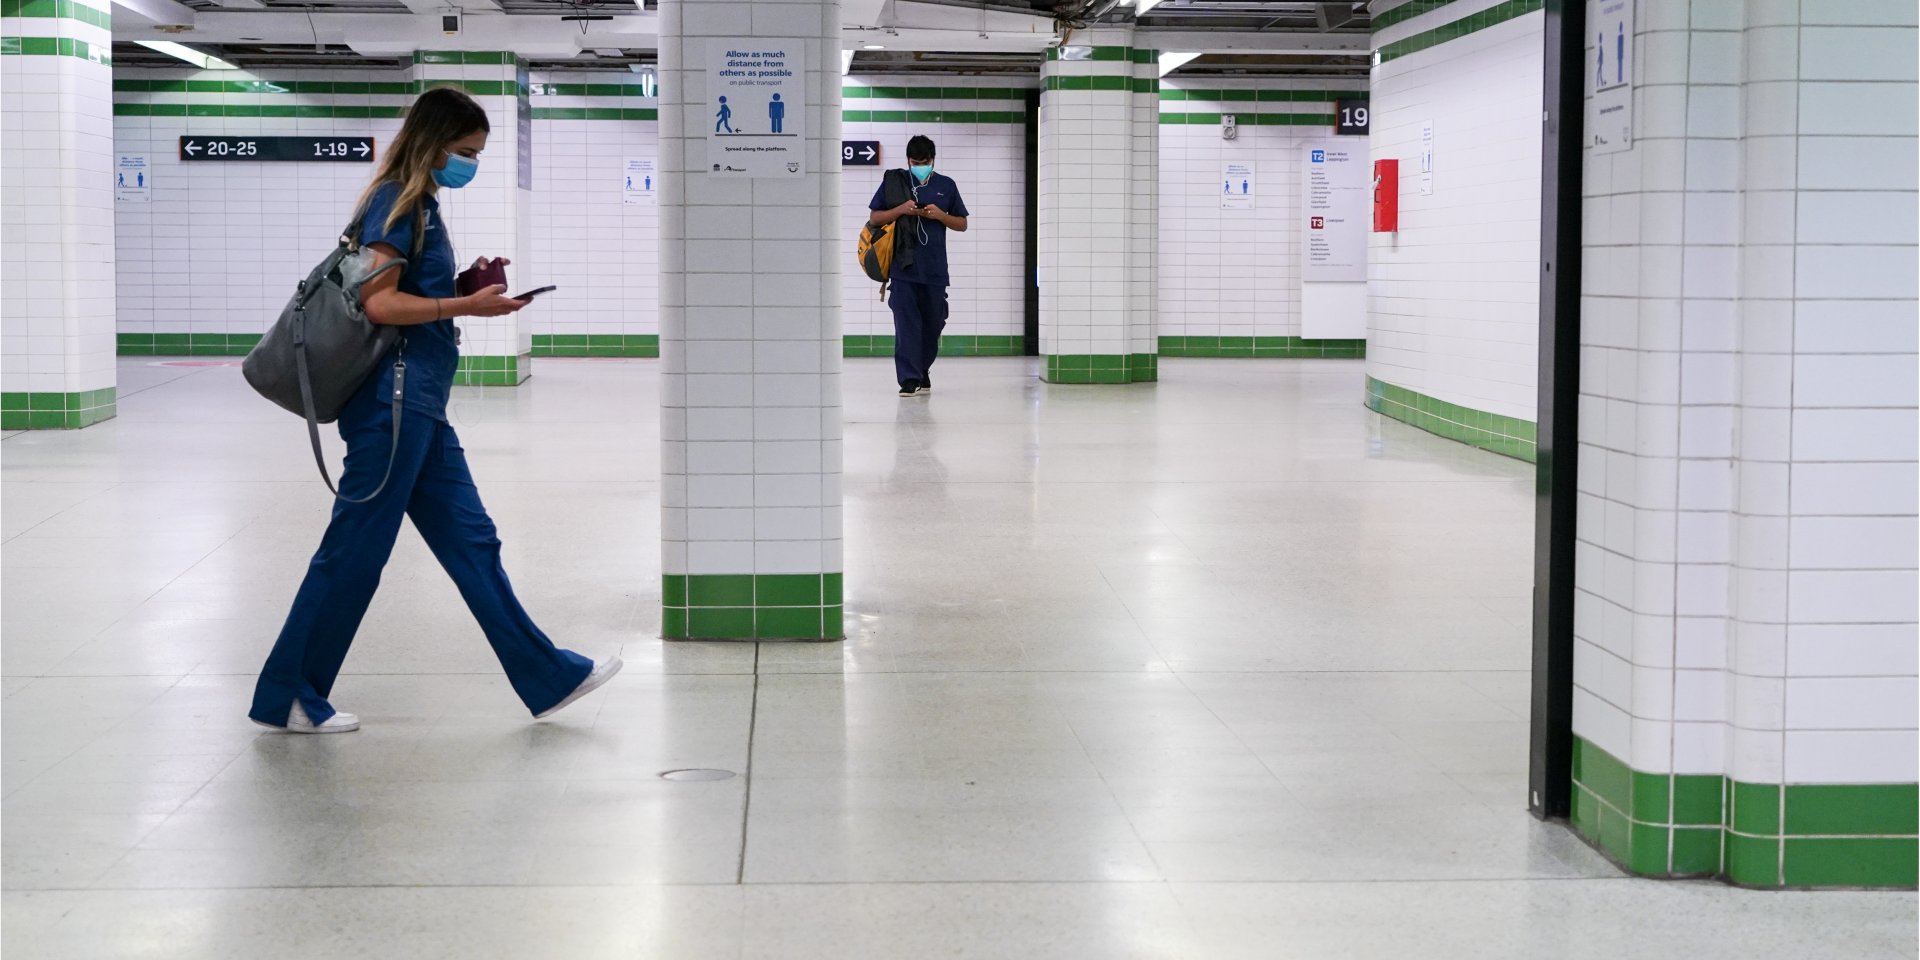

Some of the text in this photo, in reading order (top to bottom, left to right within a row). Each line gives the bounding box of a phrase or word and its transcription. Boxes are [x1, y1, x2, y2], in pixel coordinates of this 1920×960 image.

[758, 69, 792, 78] possible
[1342, 107, 1368, 127] 19
[207, 141, 257, 156] 20-25
[314, 142, 348, 156] 1-19
[842, 146, 854, 160] 9
[1312, 152, 1324, 160] T2
[1312, 218, 1323, 227] T3
